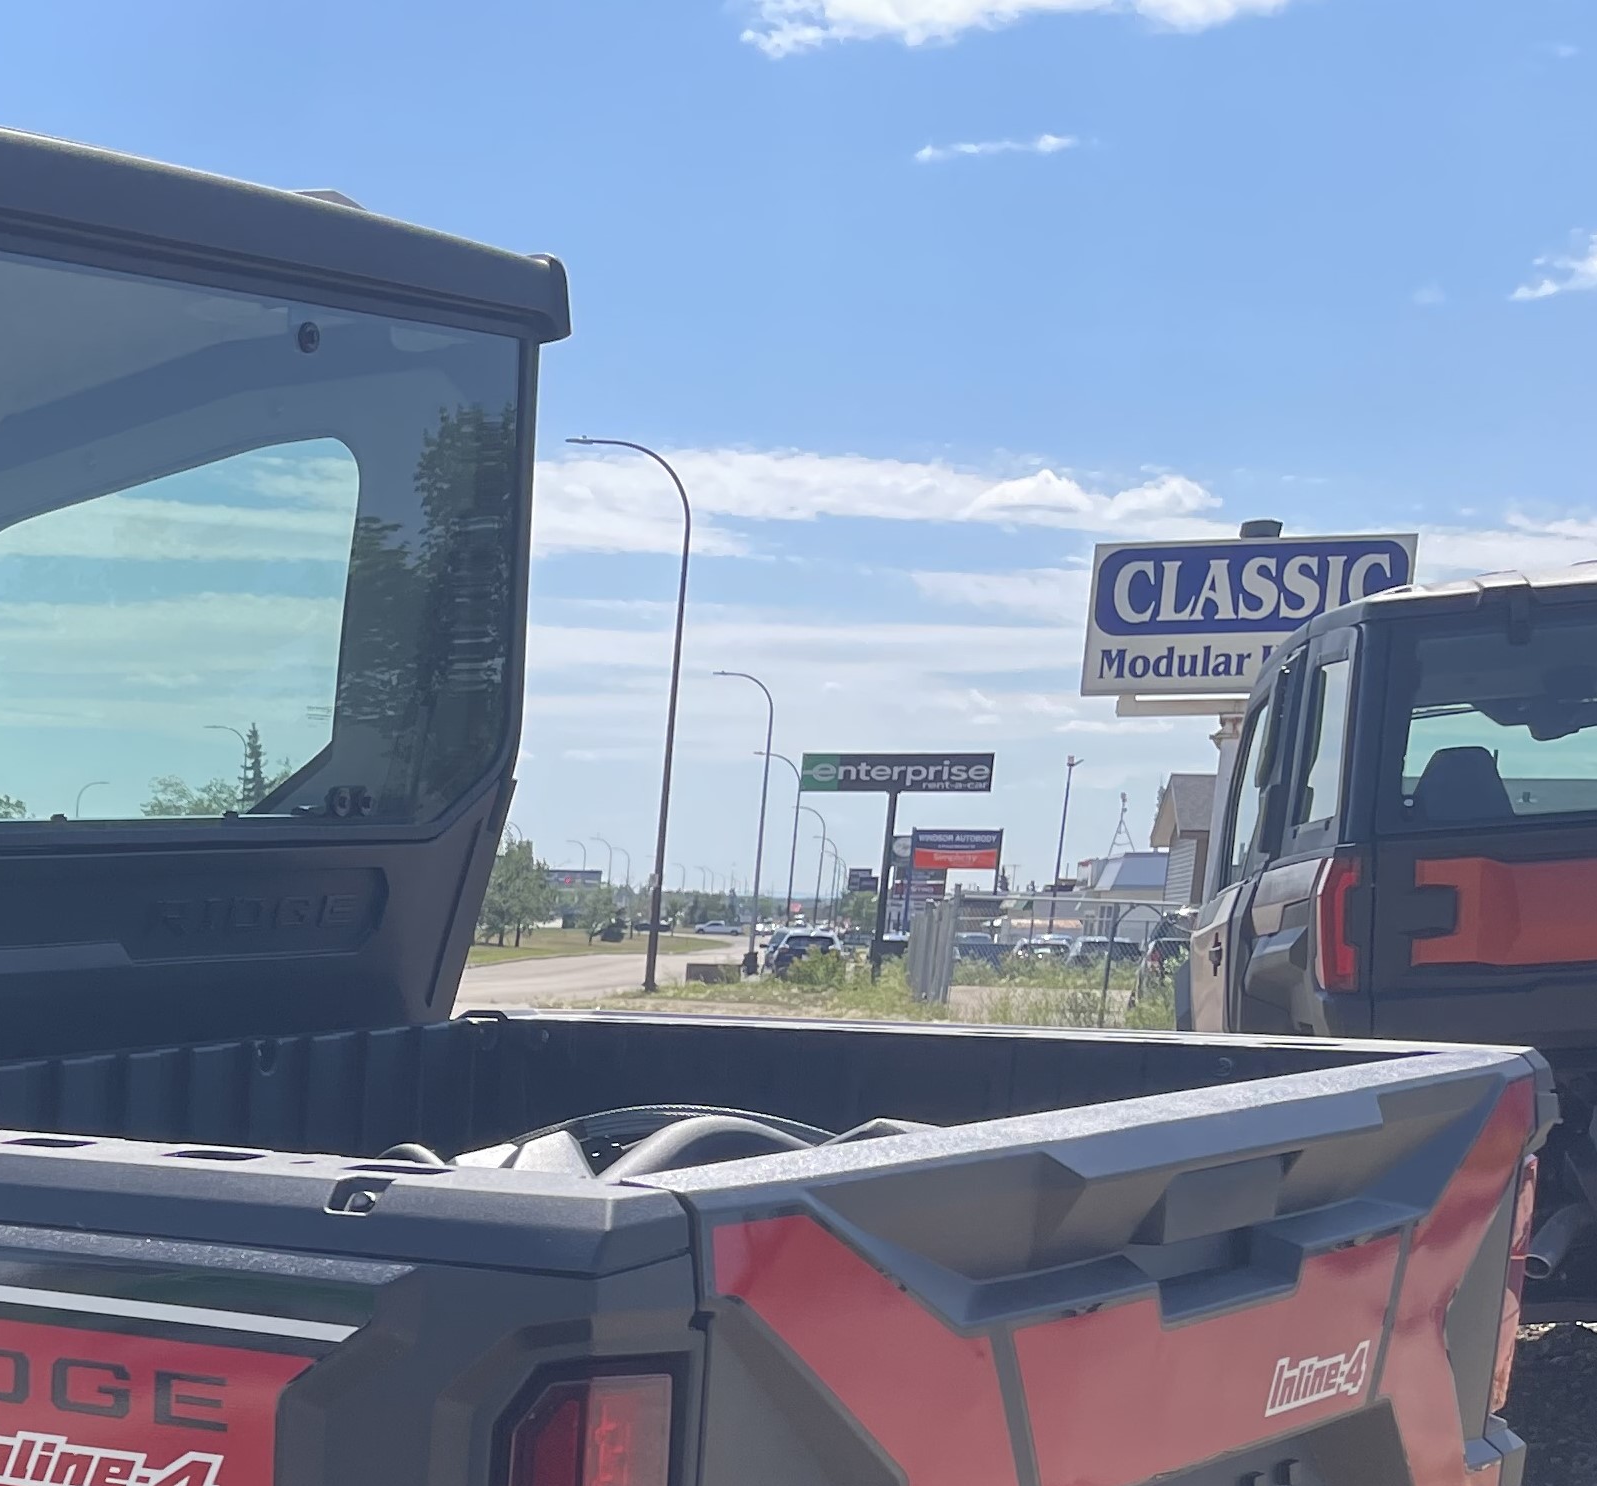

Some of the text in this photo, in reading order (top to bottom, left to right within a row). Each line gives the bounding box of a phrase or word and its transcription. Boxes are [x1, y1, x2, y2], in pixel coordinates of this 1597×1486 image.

[1113, 552, 1392, 625] CLASSIC
[1098, 645, 1251, 679] Modular
[804, 760, 990, 786] enterprise
[918, 834, 997, 842] WINDSOR AUTOBODY
[1264, 1340, 1371, 1418] Inline-4
